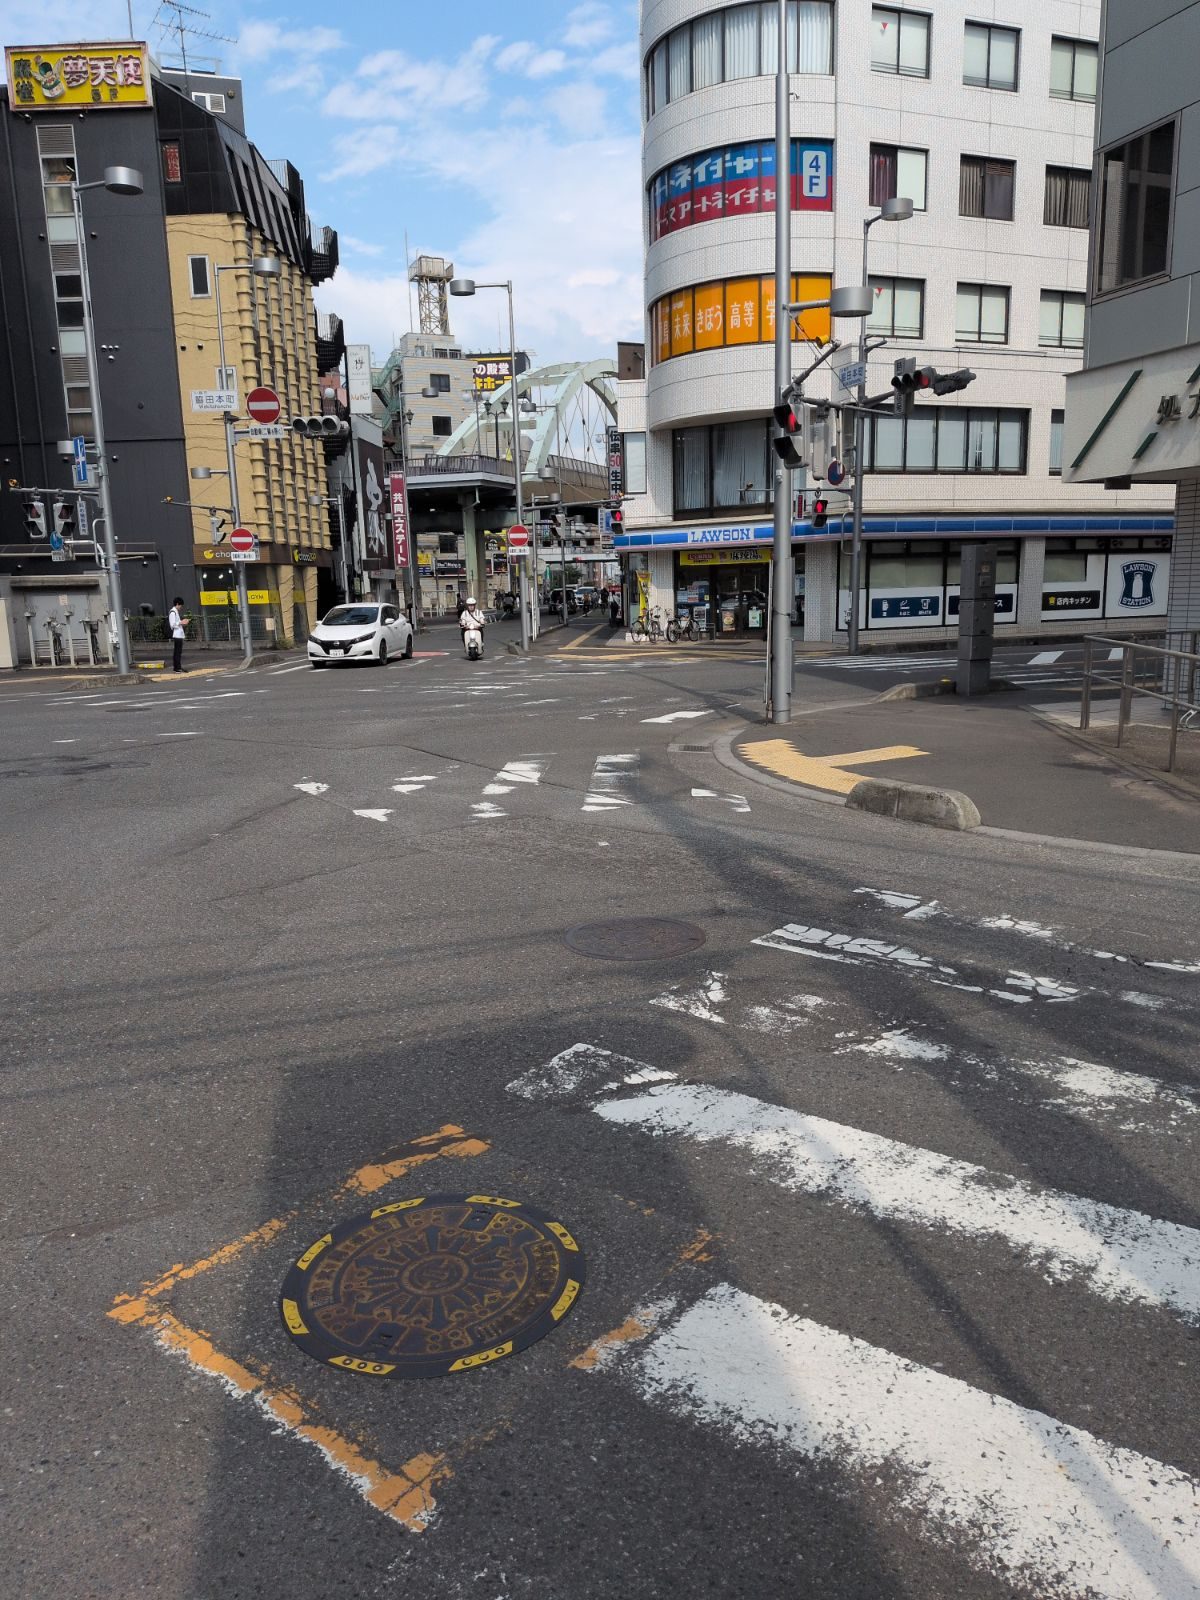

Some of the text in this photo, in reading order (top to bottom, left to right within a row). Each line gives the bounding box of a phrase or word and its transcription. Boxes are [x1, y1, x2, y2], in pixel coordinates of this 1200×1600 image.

[62, 54, 143, 88] 夢天使
[679, 186, 776, 220] アートネイチャ
[690, 528, 750, 543] LAWSON
[1123, 563, 1155, 573] LAWSON
[1056, 596, 1092, 606] 店内キッチン
[1122, 596, 1152, 607] STATION
